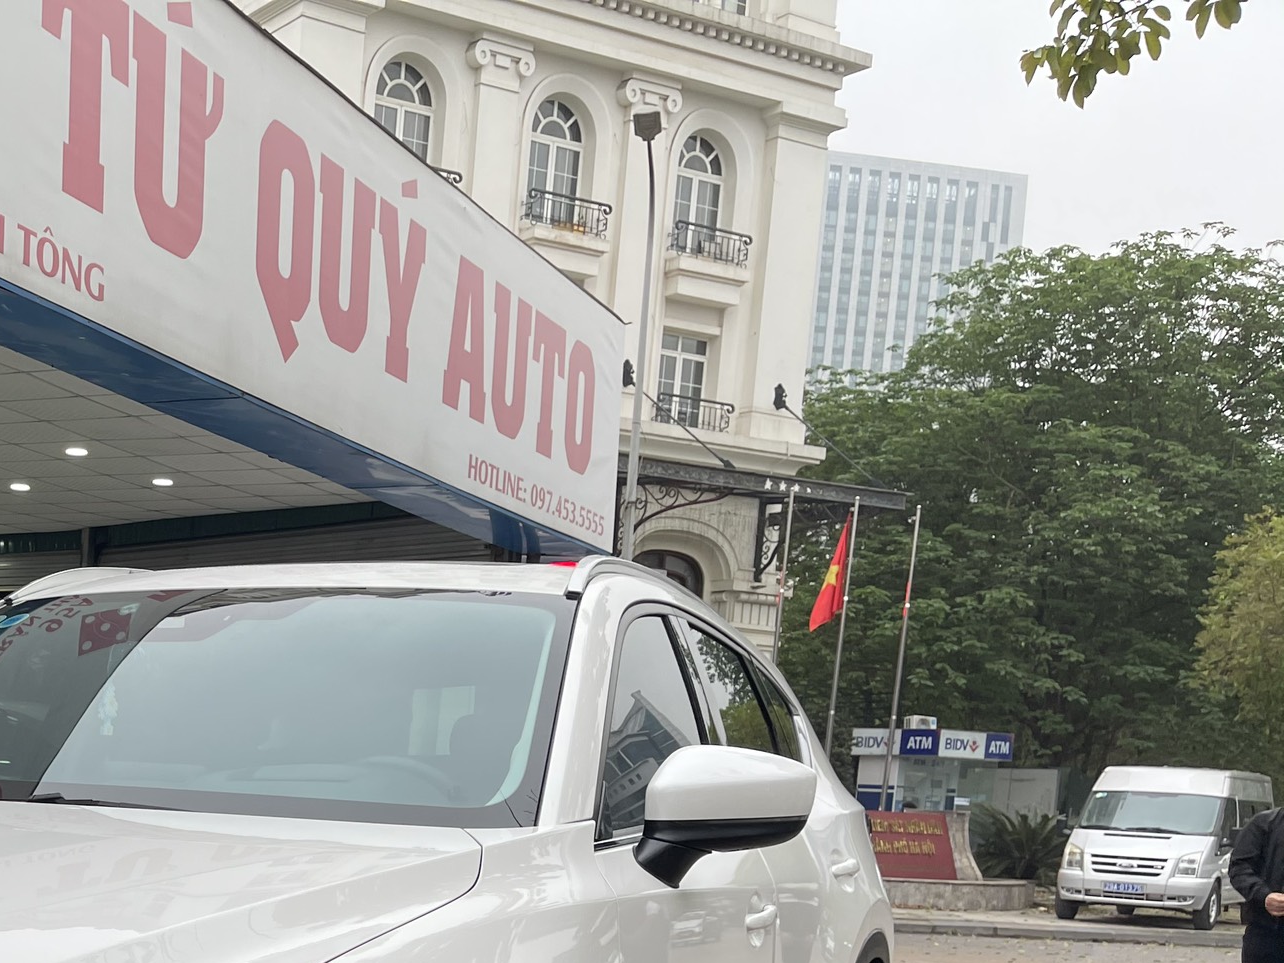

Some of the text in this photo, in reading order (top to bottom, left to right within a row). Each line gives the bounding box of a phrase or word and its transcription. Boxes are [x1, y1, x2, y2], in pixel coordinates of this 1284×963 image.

[17, 223, 105, 302] TÔNG
[256, 119, 427, 383] QUÝ
[442, 255, 595, 475] AUTO
[467, 453, 605, 537] HOTLINE: 097.453.5555
[855, 736, 933, 750] BIDV ATM
[944, 737, 1010, 756] BIDV ATM
